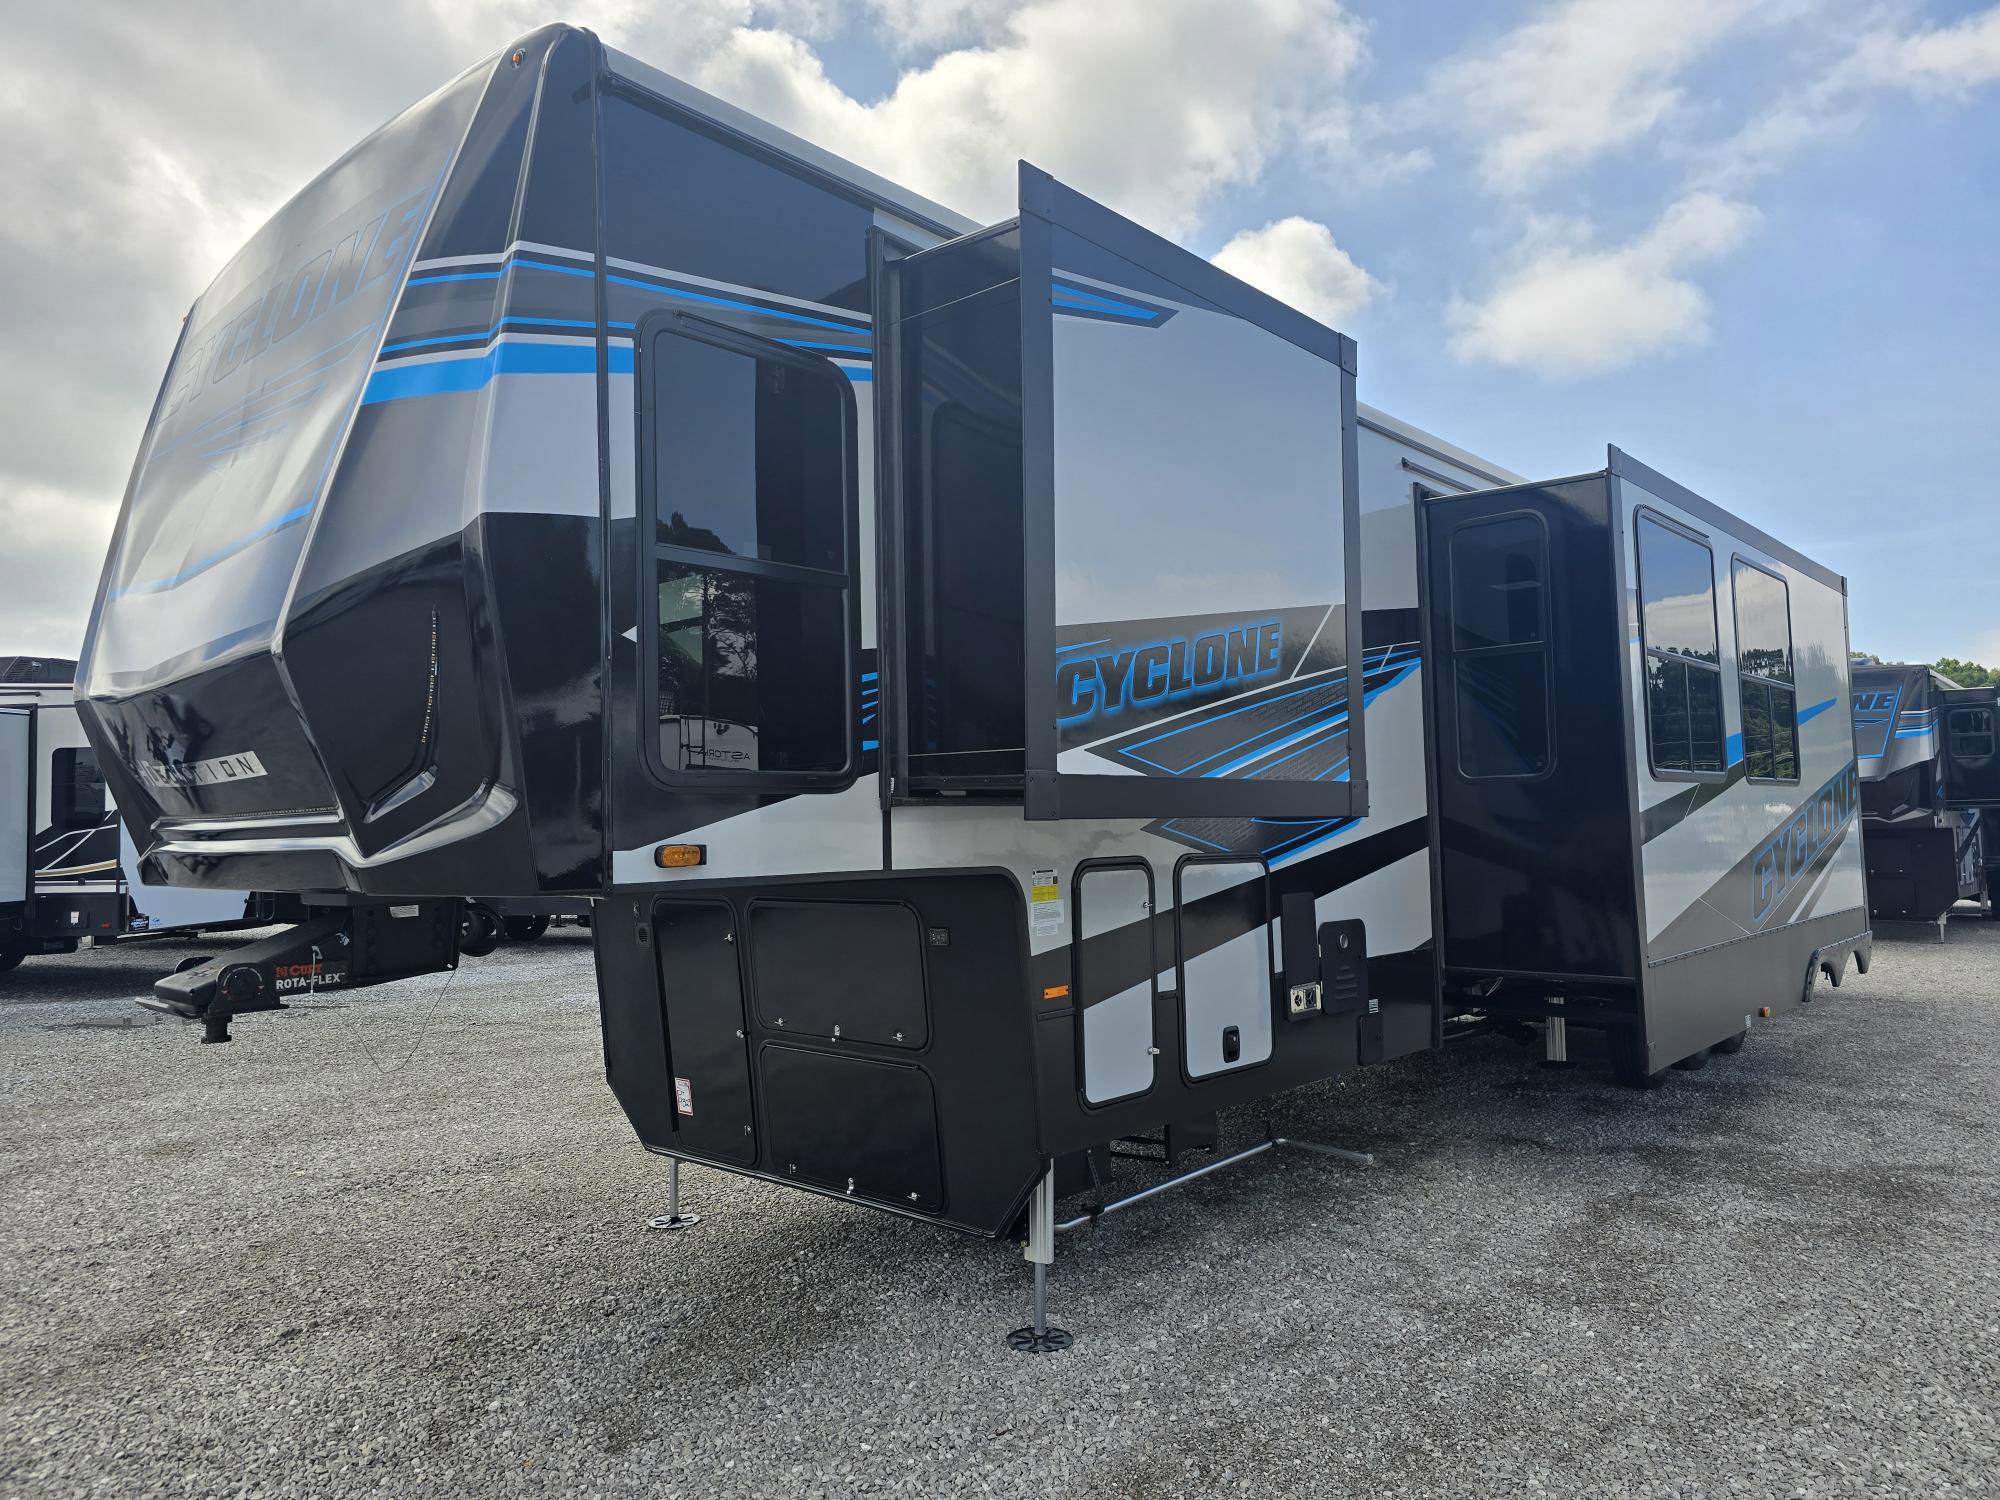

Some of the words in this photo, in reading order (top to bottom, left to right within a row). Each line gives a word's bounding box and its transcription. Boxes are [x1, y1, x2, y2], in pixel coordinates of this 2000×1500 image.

[1056, 620, 1282, 721] CYCLONE
[1752, 766, 1857, 920] CYCLONE
[276, 973, 341, 990] ROTA-FLEX
